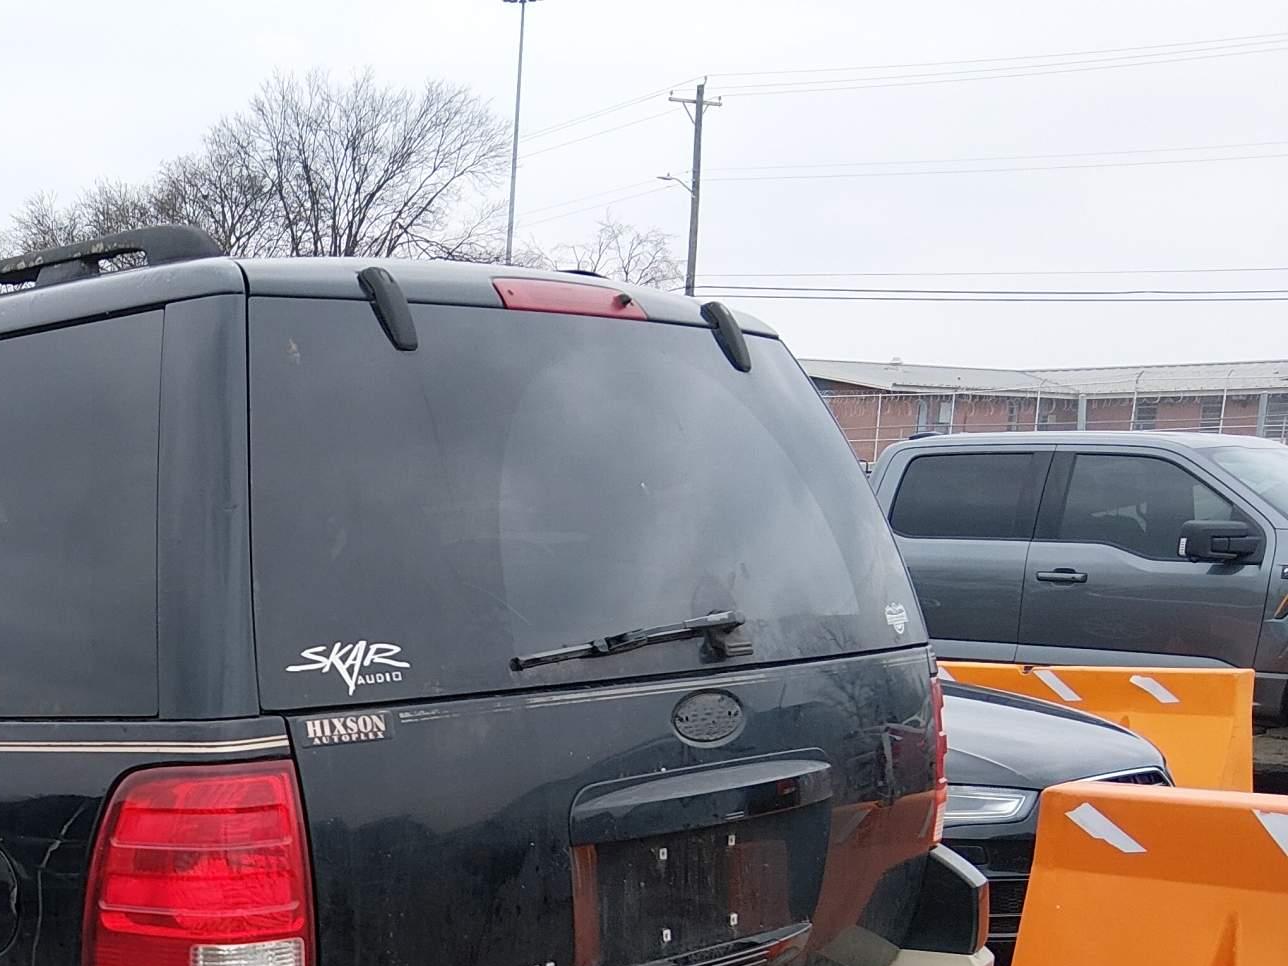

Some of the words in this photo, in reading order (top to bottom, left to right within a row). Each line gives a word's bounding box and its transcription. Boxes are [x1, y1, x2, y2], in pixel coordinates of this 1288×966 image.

[285, 640, 410, 696] SKAR
[357, 671, 403, 685] AUDIO
[305, 714, 387, 738] HIXSON
[312, 731, 386, 746] AUTOPLEX
